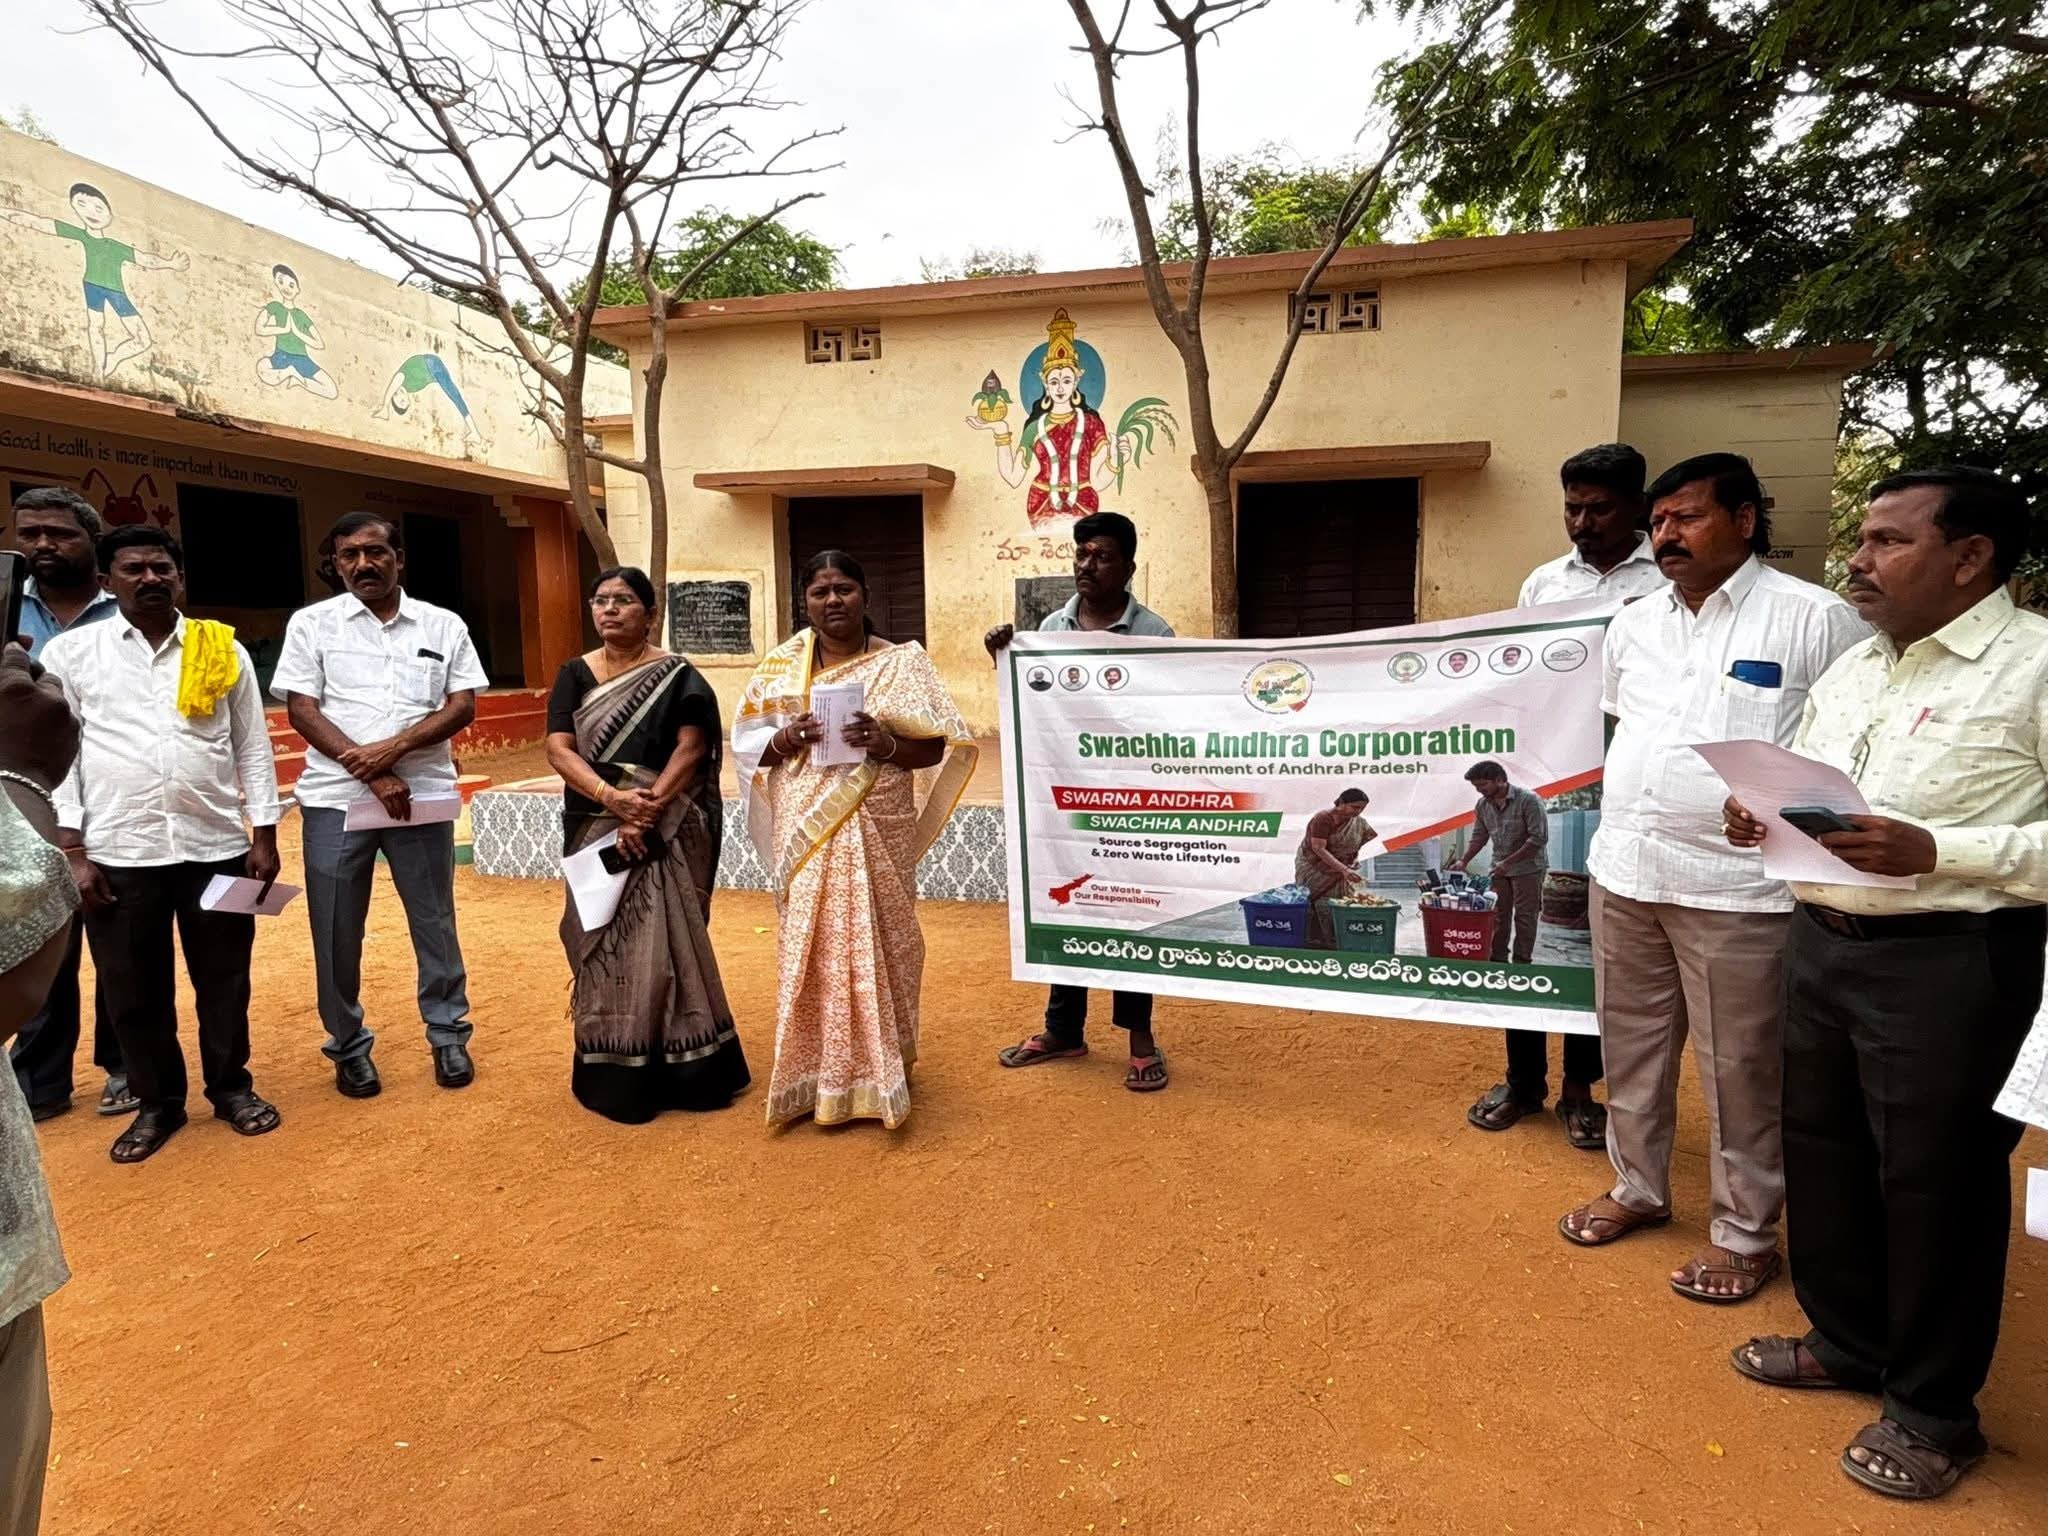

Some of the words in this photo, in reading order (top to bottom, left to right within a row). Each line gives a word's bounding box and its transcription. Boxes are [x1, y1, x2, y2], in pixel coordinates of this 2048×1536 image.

[0, 429, 41, 451] Good
[47, 434, 94, 459] health
[98, 441, 111, 460] is
[115, 448, 149, 466] more
[152, 449, 214, 477] important
[218, 461, 249, 481] than
[253, 471, 298, 492] money
[996, 537, 1031, 561] మా
[1078, 732, 1196, 758] Swachha
[1204, 731, 1309, 758] Andhra
[1319, 724, 1516, 760] Corporation
[1151, 763, 1252, 775] Government
[1257, 763, 1275, 774] of
[1279, 763, 1345, 774] Andhra
[1349, 762, 1428, 774] Pradesh
[1062, 791, 1140, 806] SWARNA
[1146, 793, 1234, 808] ANDHRA
[1089, 815, 1183, 830] SWACHHA
[1186, 818, 1270, 832] ANDHRA
[1098, 837, 1142, 848] Source
[1144, 838, 1227, 851] Segregation
[1091, 848, 1101, 857] &
[1103, 849, 1129, 860] Zero
[1132, 851, 1174, 861] Waste
[1176, 852, 1241, 865] Lifestyles
[1090, 883, 1108, 891] Our
[1109, 885, 1142, 894] Waste
[1074, 891, 1091, 900] Our
[1092, 892, 1161, 907] Responsibility
[1062, 937, 1153, 961] మండిగిరి
[1158, 946, 1212, 968] గ్రామ
[1428, 965, 1560, 994] మండలం.
